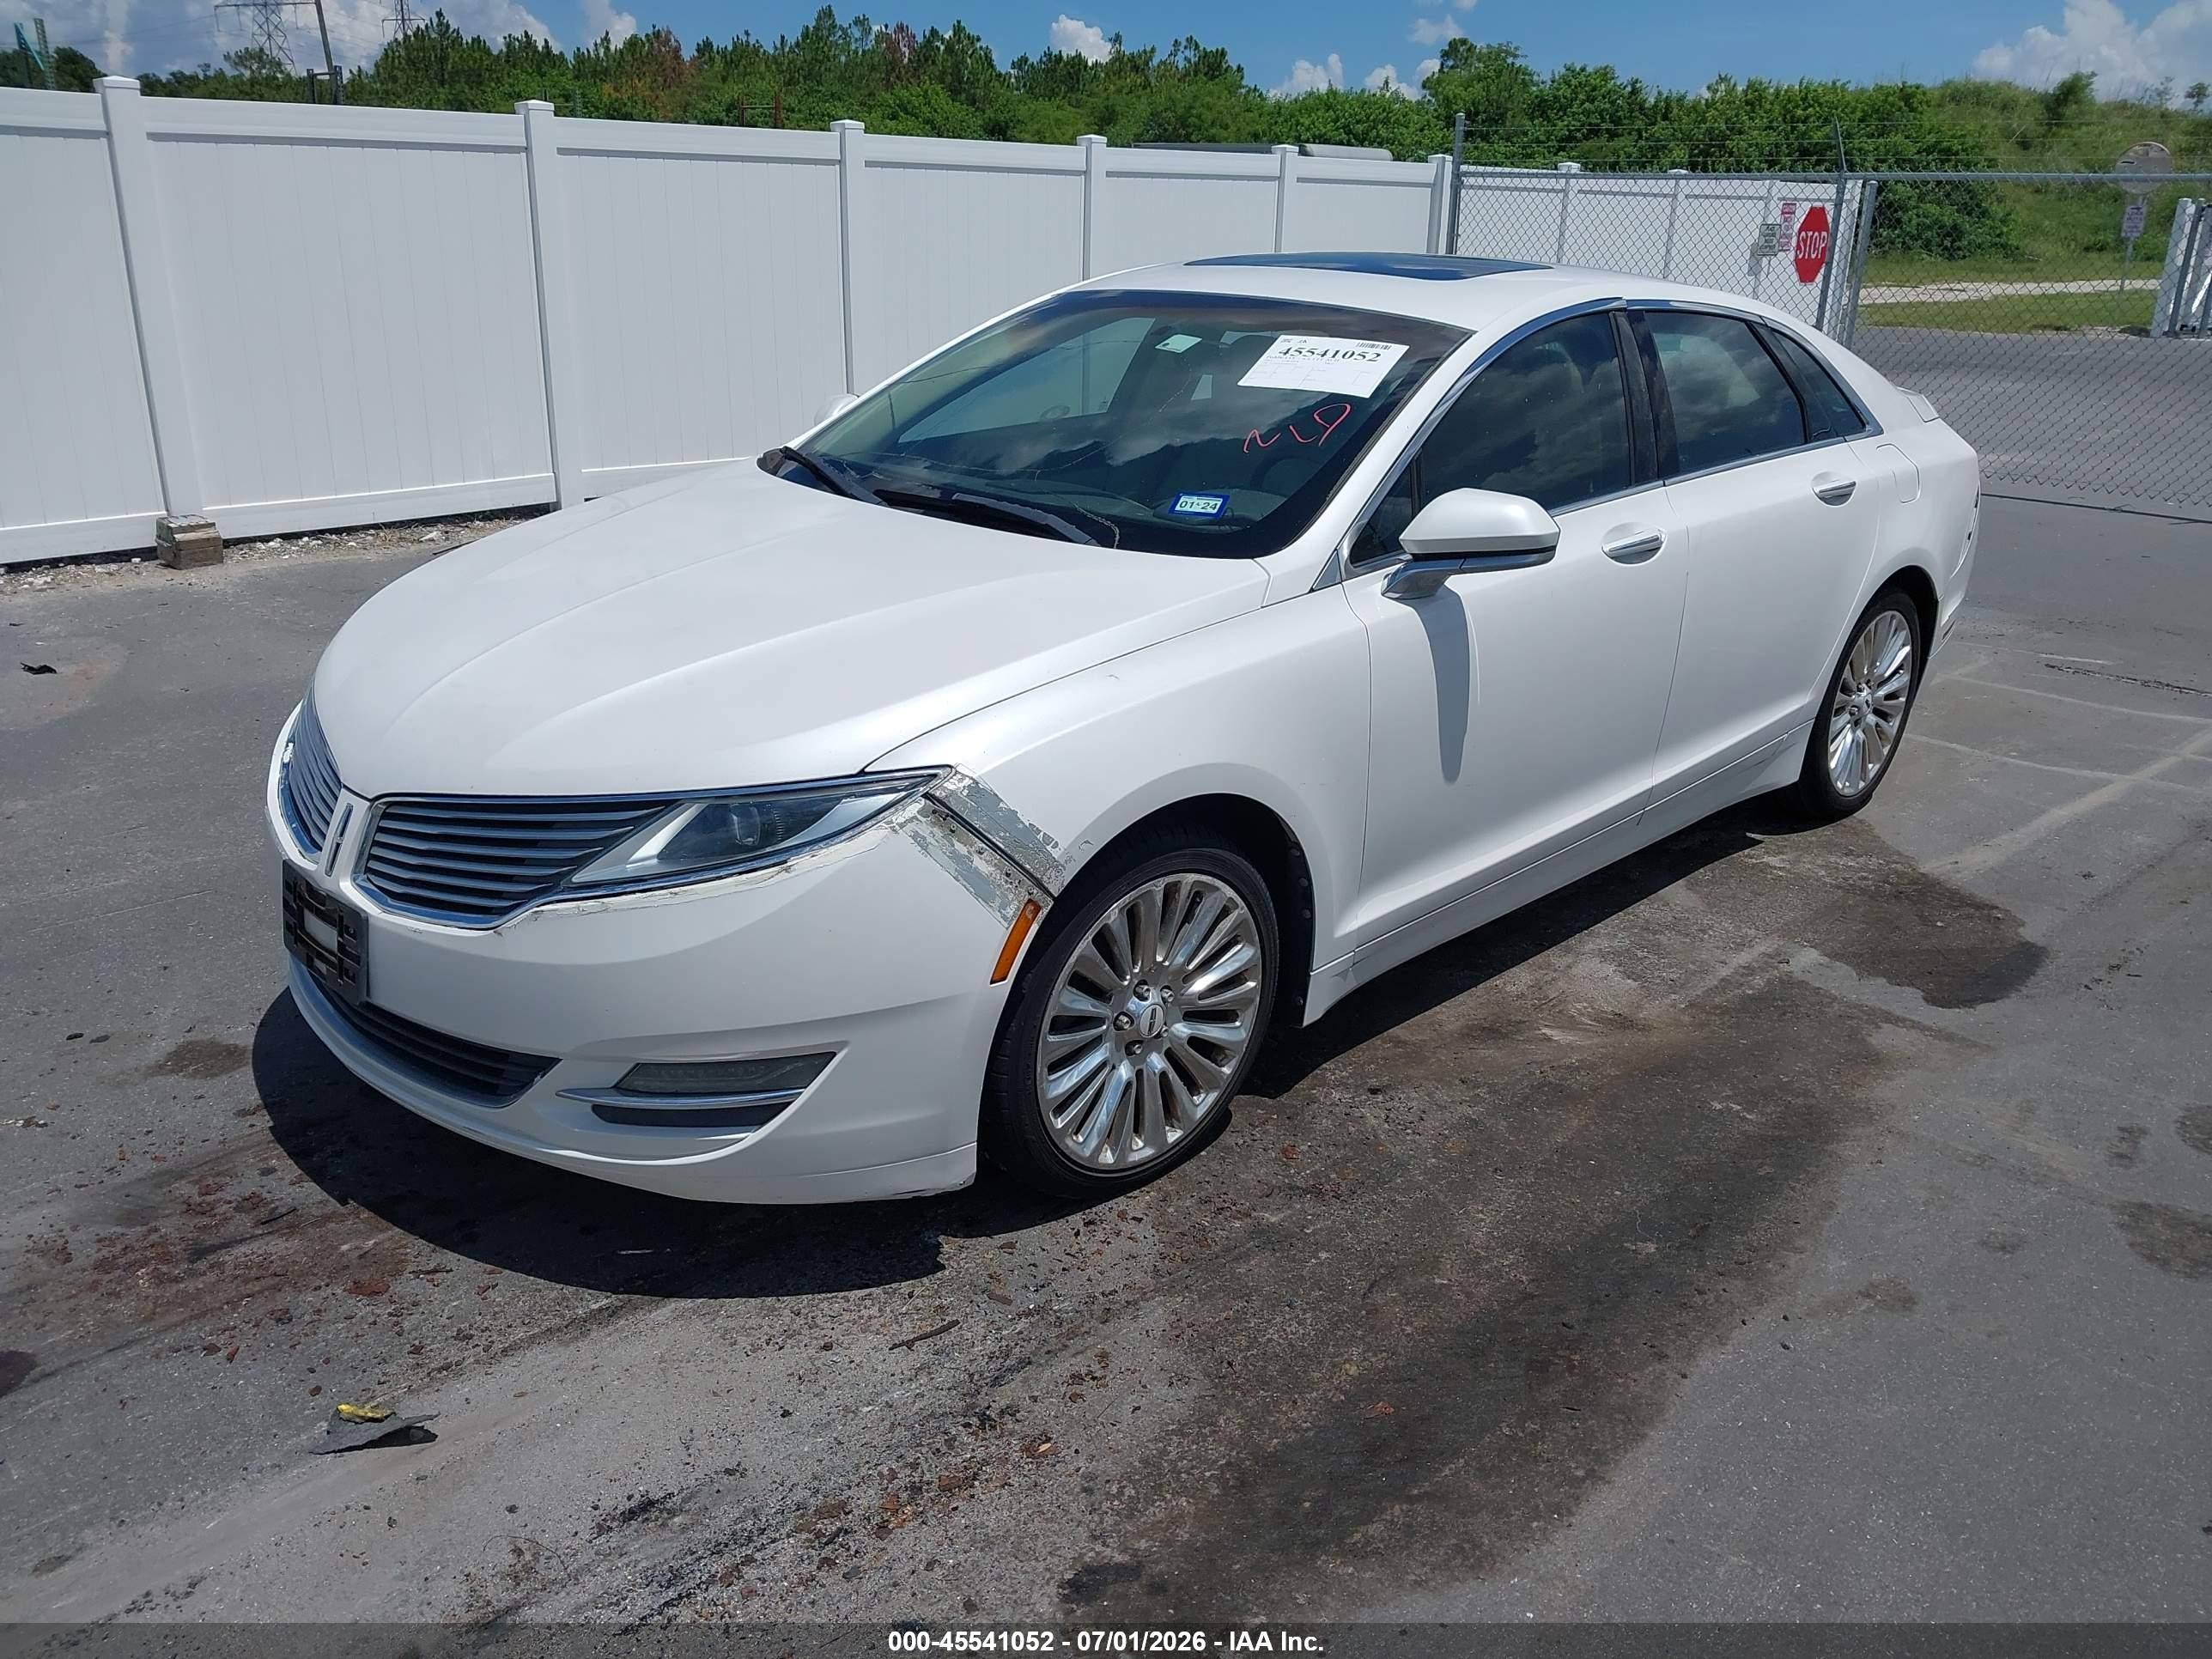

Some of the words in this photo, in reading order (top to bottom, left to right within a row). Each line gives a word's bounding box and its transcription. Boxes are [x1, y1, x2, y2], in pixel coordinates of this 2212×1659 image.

[1796, 231, 1828, 259] STOP
[1278, 346, 1382, 362] 45541052
[1200, 501, 1218, 511] 24
